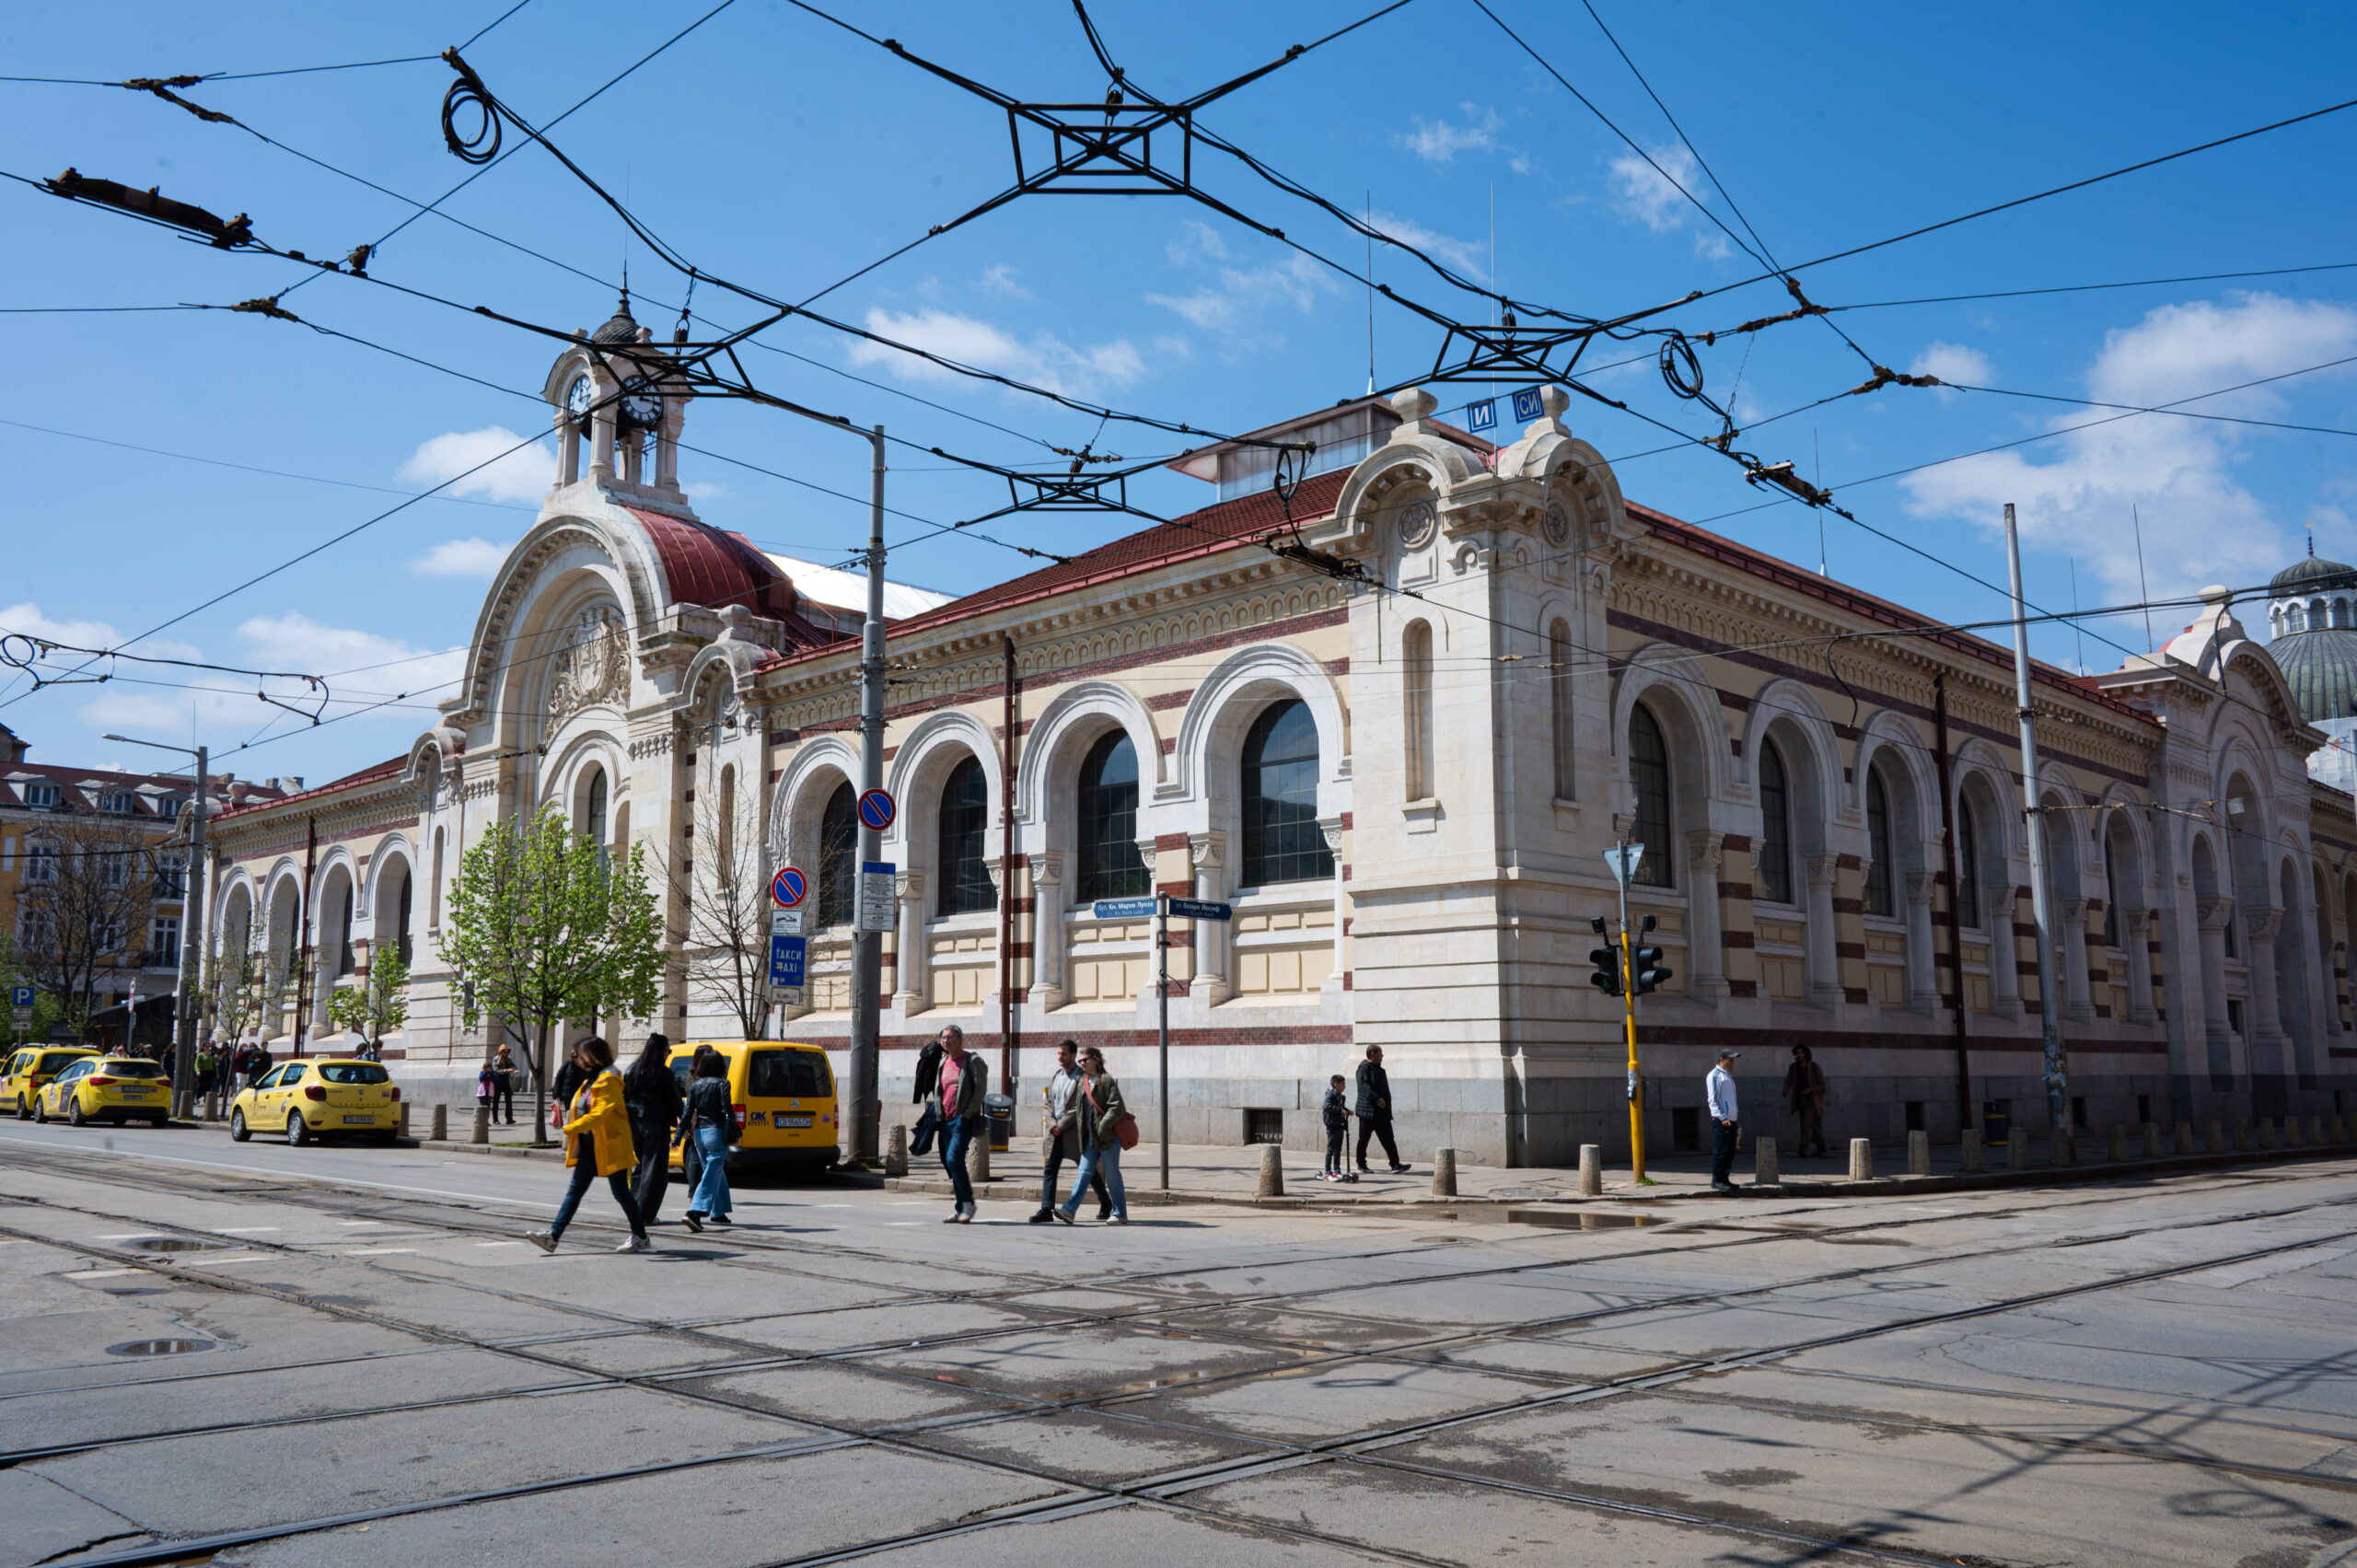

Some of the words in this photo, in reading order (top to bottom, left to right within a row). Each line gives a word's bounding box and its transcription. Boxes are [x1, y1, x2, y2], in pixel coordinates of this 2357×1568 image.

[1519, 393, 1538, 415] СИ
[1475, 405, 1490, 425] И
[1119, 902, 1135, 911] Мария
[1184, 902, 1200, 911] Екзарх
[1202, 902, 1220, 912] Йосиф
[776, 947, 801, 960] ТАКСИ
[17, 988, 29, 1004] P
[750, 1111, 766, 1121] OK
